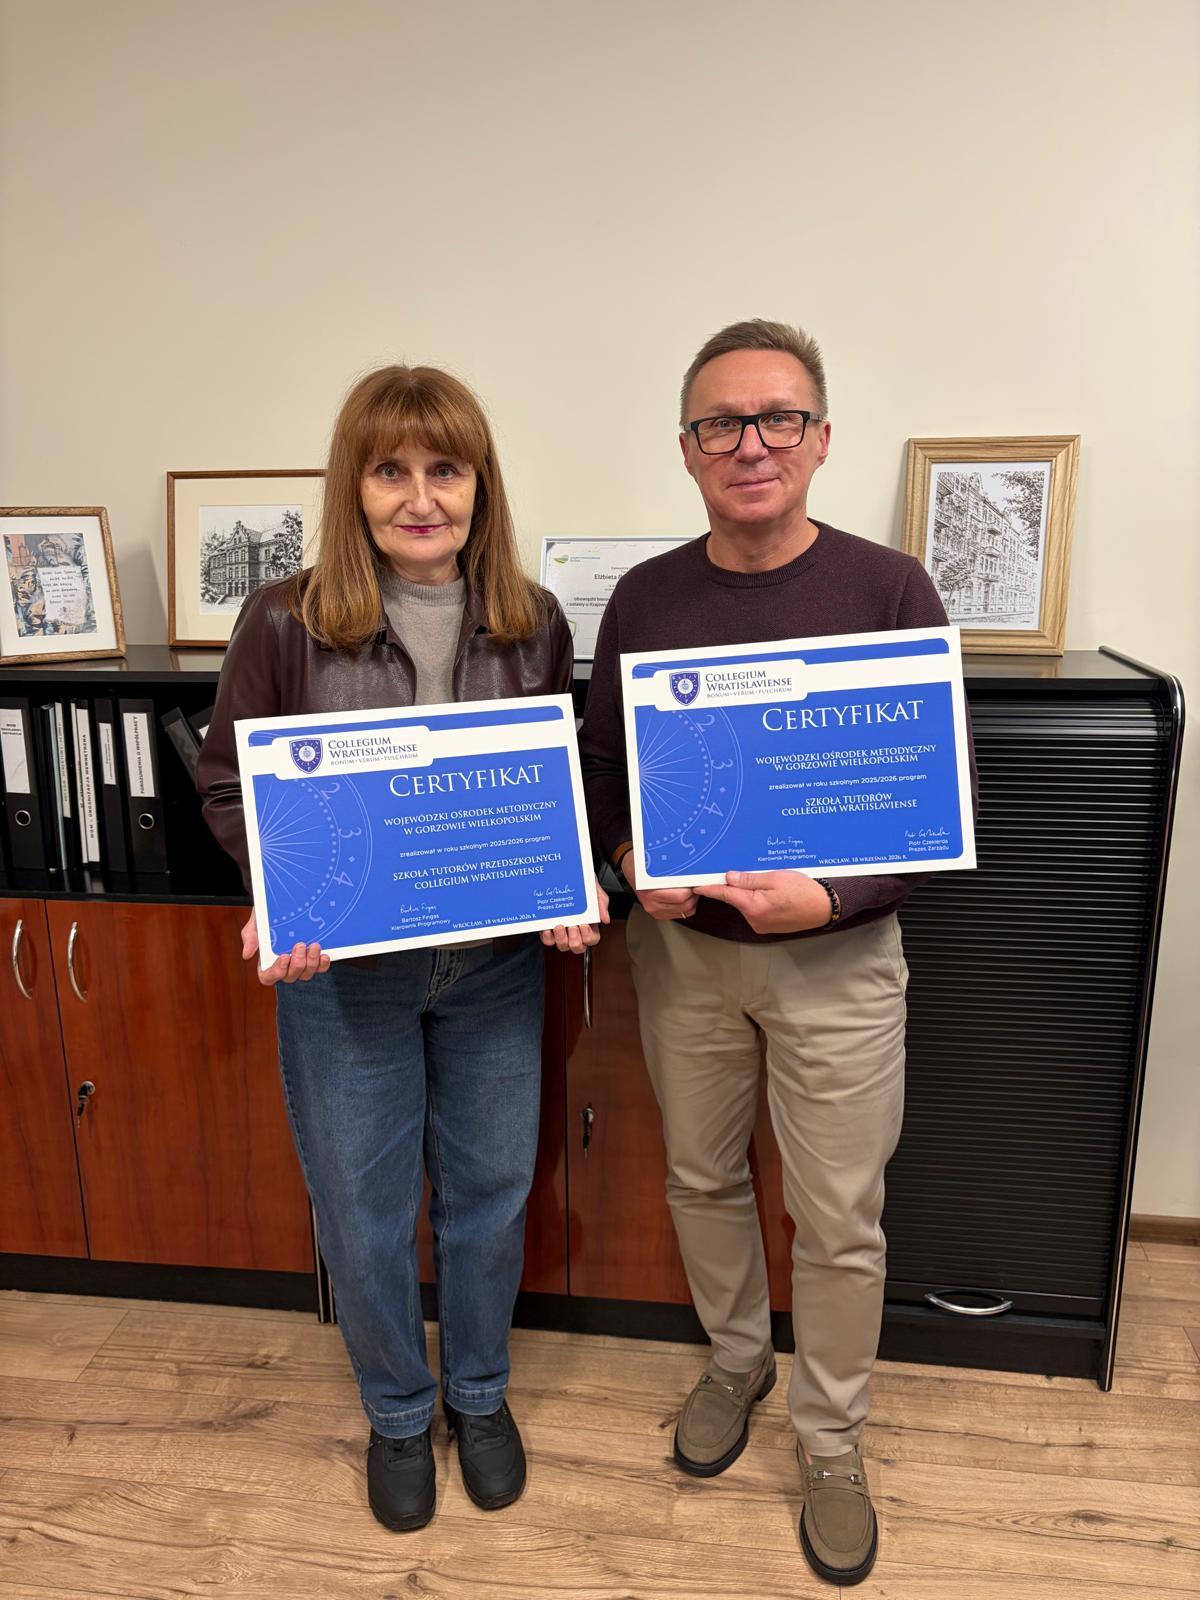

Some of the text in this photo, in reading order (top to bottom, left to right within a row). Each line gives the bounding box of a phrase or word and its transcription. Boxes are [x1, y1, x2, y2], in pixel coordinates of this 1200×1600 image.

[705, 670, 767, 683] COLLEGIUM
[706, 677, 792, 692] WRATISLAVIENSE
[762, 700, 924, 732] CERTYFIKAT
[327, 736, 392, 750] COLLEGIUM
[329, 743, 418, 759] WRATISLAVIENSE
[755, 744, 937, 765] WOJEWÓDZKI OŚRODEK METODYCZNY
[773, 754, 919, 772] W GORZOWIE WIELKOPOLSKIM
[711, 759, 733, 771] 3
[389, 764, 544, 797] CERTYFIKAT
[860, 775, 898, 784] 2025/2026
[898, 774, 927, 782] program
[805, 791, 892, 807] SZKOŁA TUTORÓW
[383, 800, 557, 826] WOJEWÓDZKI OŚRODEK METODYCZNY
[703, 801, 724, 818] 4
[781, 799, 918, 817] COLLEGIUM WRATISLAVIENSE
[338, 826, 363, 839] 3
[403, 813, 542, 835] W GORZOWIE WIELKOPOLSKIM
[459, 842, 489, 851] szkolnym
[489, 837, 524, 848] 2025/2026
[524, 835, 551, 844] program
[393, 852, 562, 881] SZKOŁA TUTORÓW PRZEDSZKOLNYCH
[333, 871, 355, 888] 4
[414, 865, 545, 890] COLLEGIUM WRATISLAVIENSE
[417, 919, 451, 928] Programowy
